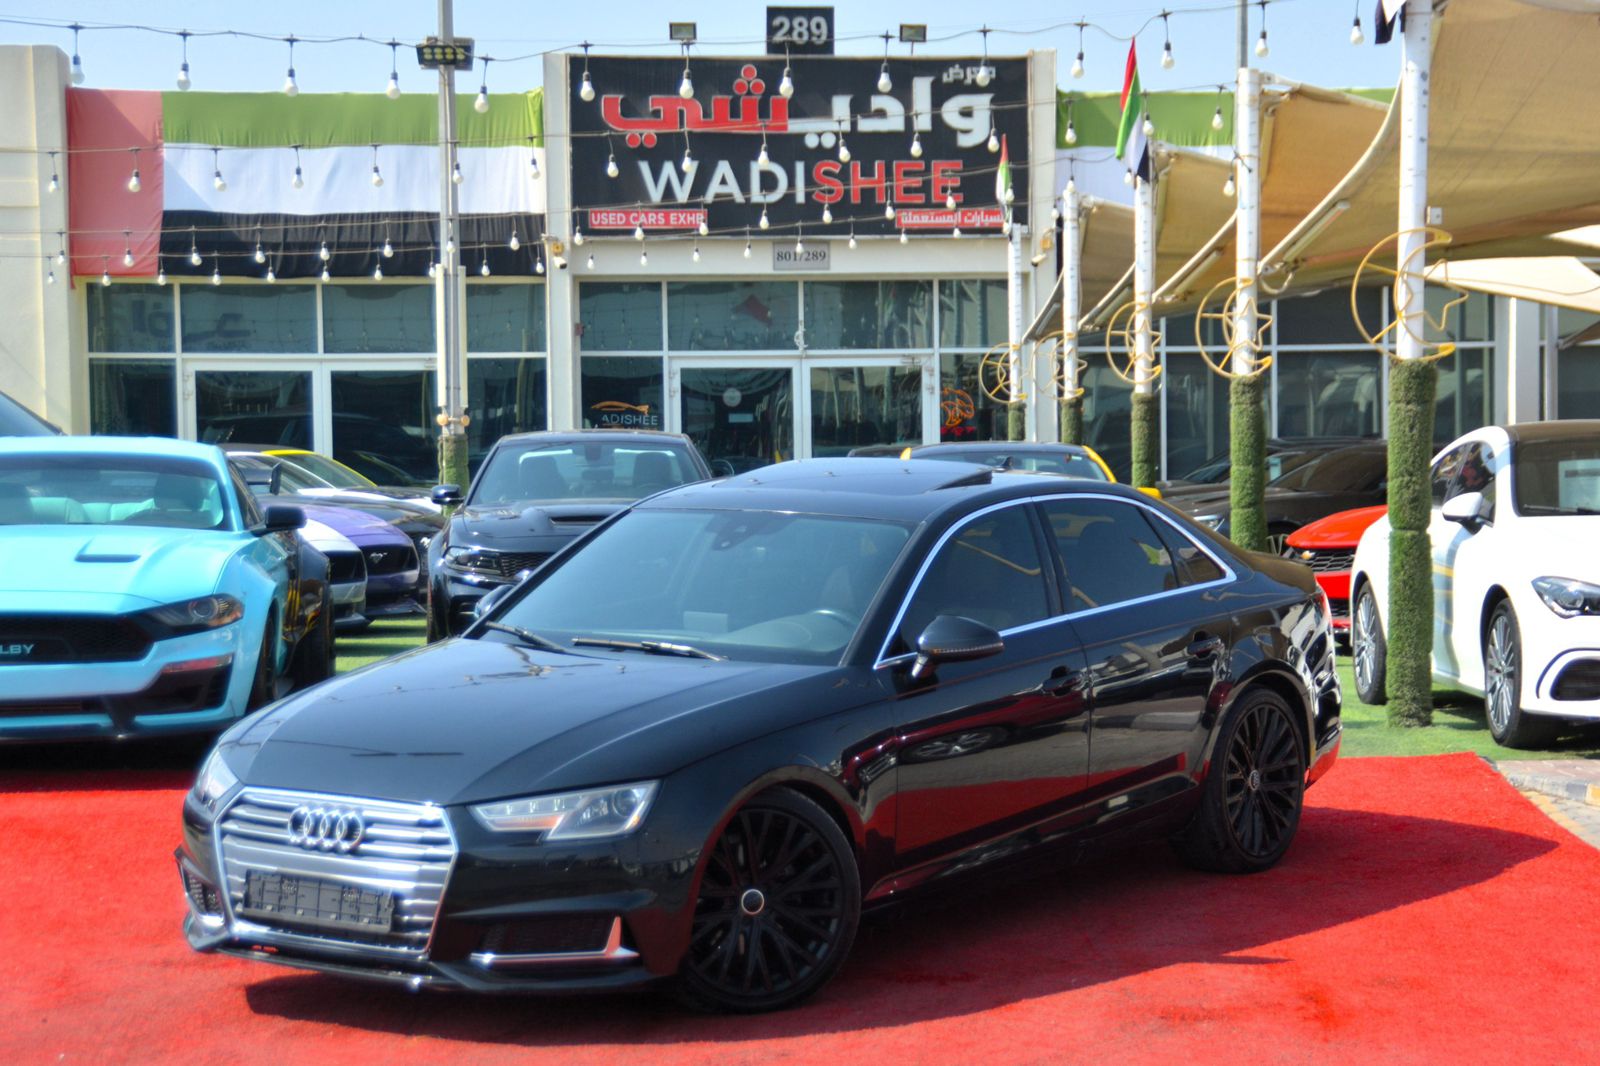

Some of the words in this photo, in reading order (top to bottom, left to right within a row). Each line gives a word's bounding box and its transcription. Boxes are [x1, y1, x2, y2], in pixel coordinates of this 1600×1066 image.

[772, 16, 828, 44] 289
[637, 160, 964, 204] WADISHEE
[591, 213, 626, 225] USED
[629, 213, 665, 225] CARS
[776, 250, 827, 262] 801/289
